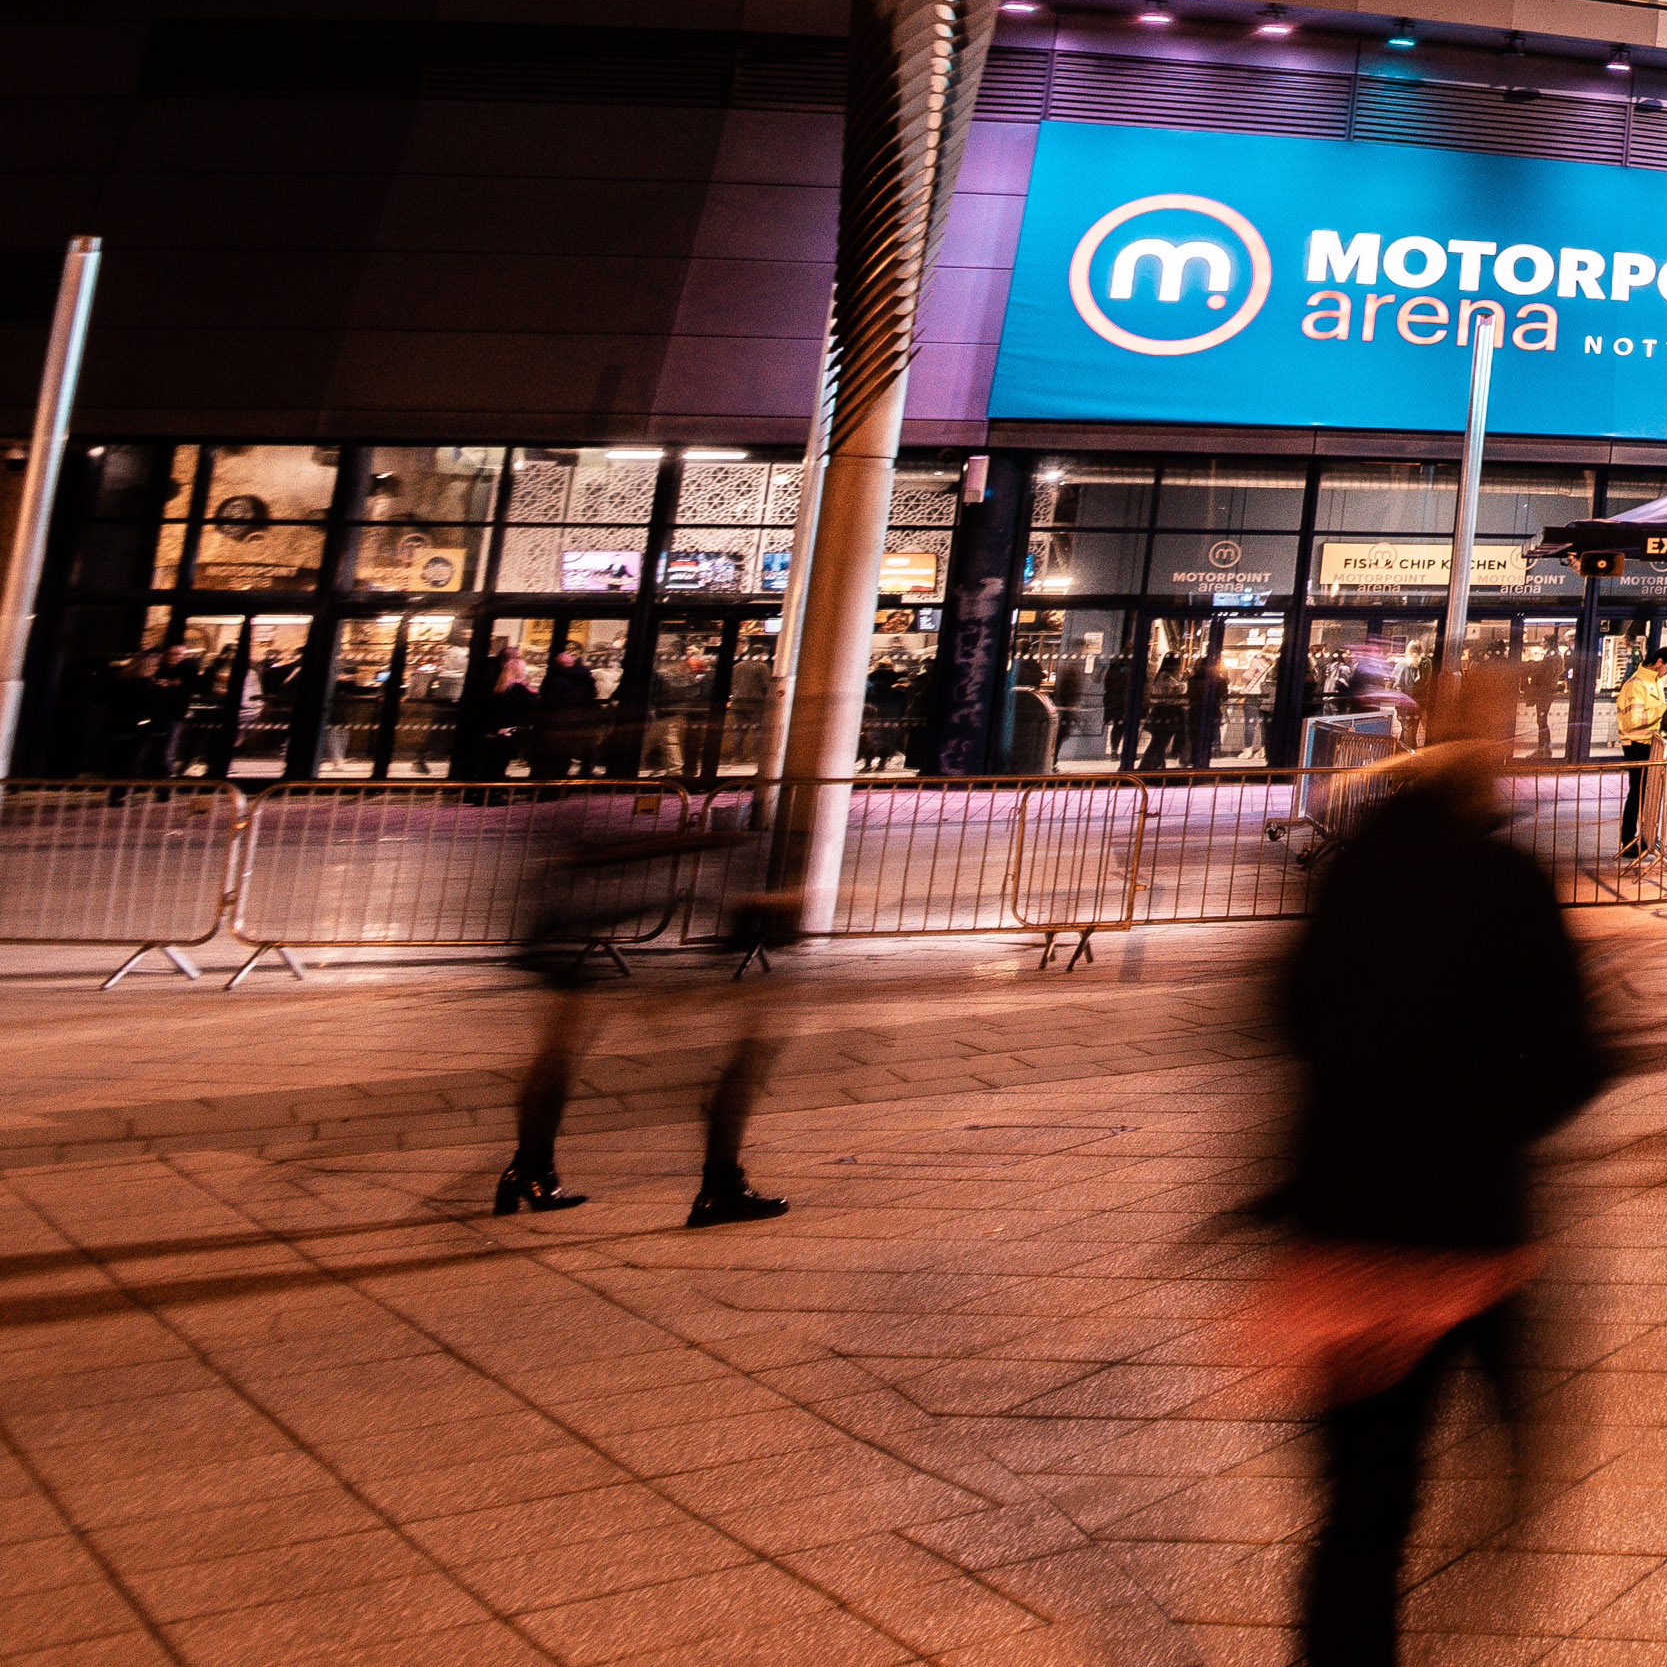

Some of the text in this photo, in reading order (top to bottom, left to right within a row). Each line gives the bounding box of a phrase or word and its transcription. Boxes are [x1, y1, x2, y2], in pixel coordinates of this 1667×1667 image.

[1301, 290, 1559, 352] arena
[1343, 558, 1378, 569] FISH
[1400, 559, 1435, 570] CHIP
[1441, 560, 1507, 570] KCHEN
[1172, 572, 1272, 583] MOTORPOINT
[1333, 574, 1427, 584] MOTORPOINT
[1478, 574, 1566, 585] MOTORPOINT
[1199, 582, 1244, 593] arena
[1357, 583, 1401, 593] arena
[1500, 582, 1541, 594] arena
